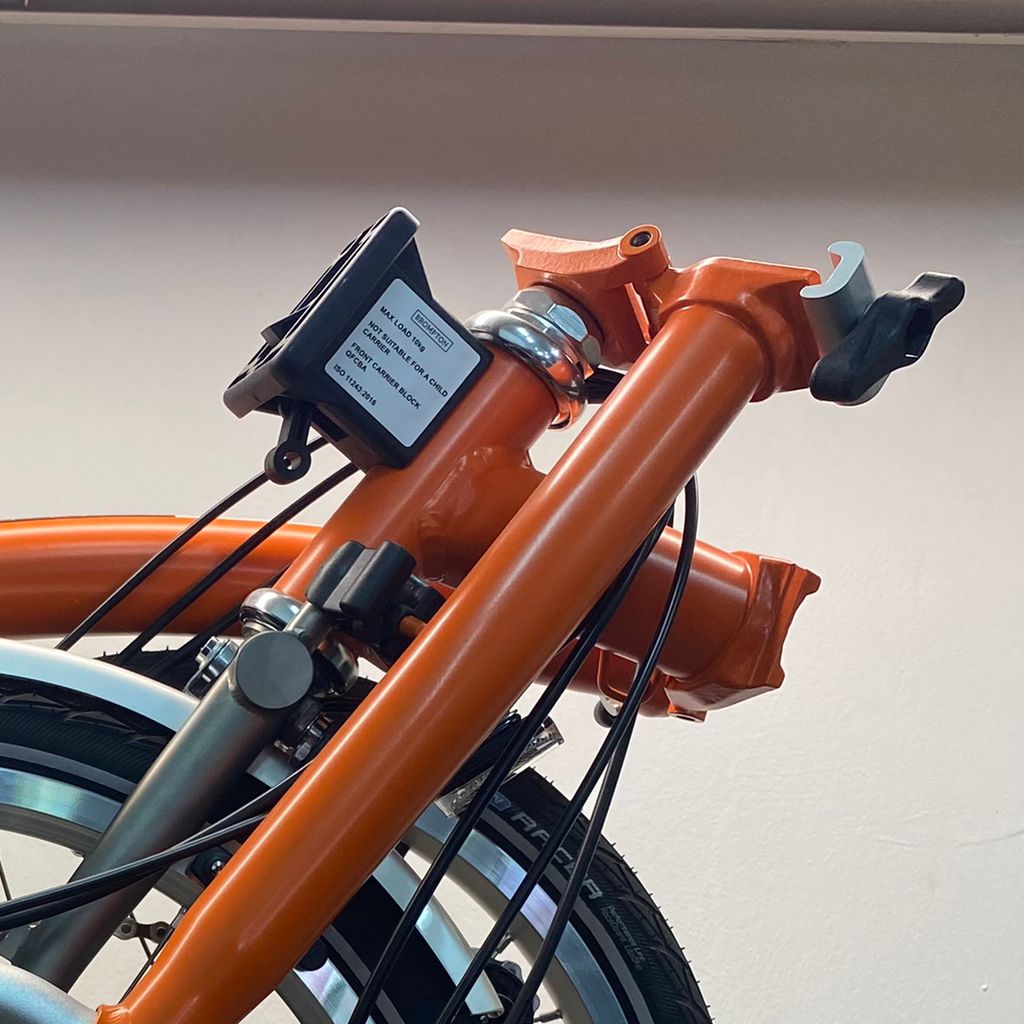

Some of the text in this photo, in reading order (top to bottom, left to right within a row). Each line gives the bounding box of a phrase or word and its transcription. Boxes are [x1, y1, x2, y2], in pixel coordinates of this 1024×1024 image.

[362, 328, 391, 356] CARRIER
[380, 306, 426, 352] MAX LOAD 10kg
[414, 314, 449, 347] BROMPTON
[333, 363, 346, 376] ISO
[345, 350, 367, 372] QFCBA
[368, 320, 383, 335] NOT
[381, 333, 412, 363] SUITABLE
[410, 360, 425, 375] FOR
[429, 378, 448, 397] CHILD
[351, 342, 421, 409] FRONT CARRIER BLOCK
